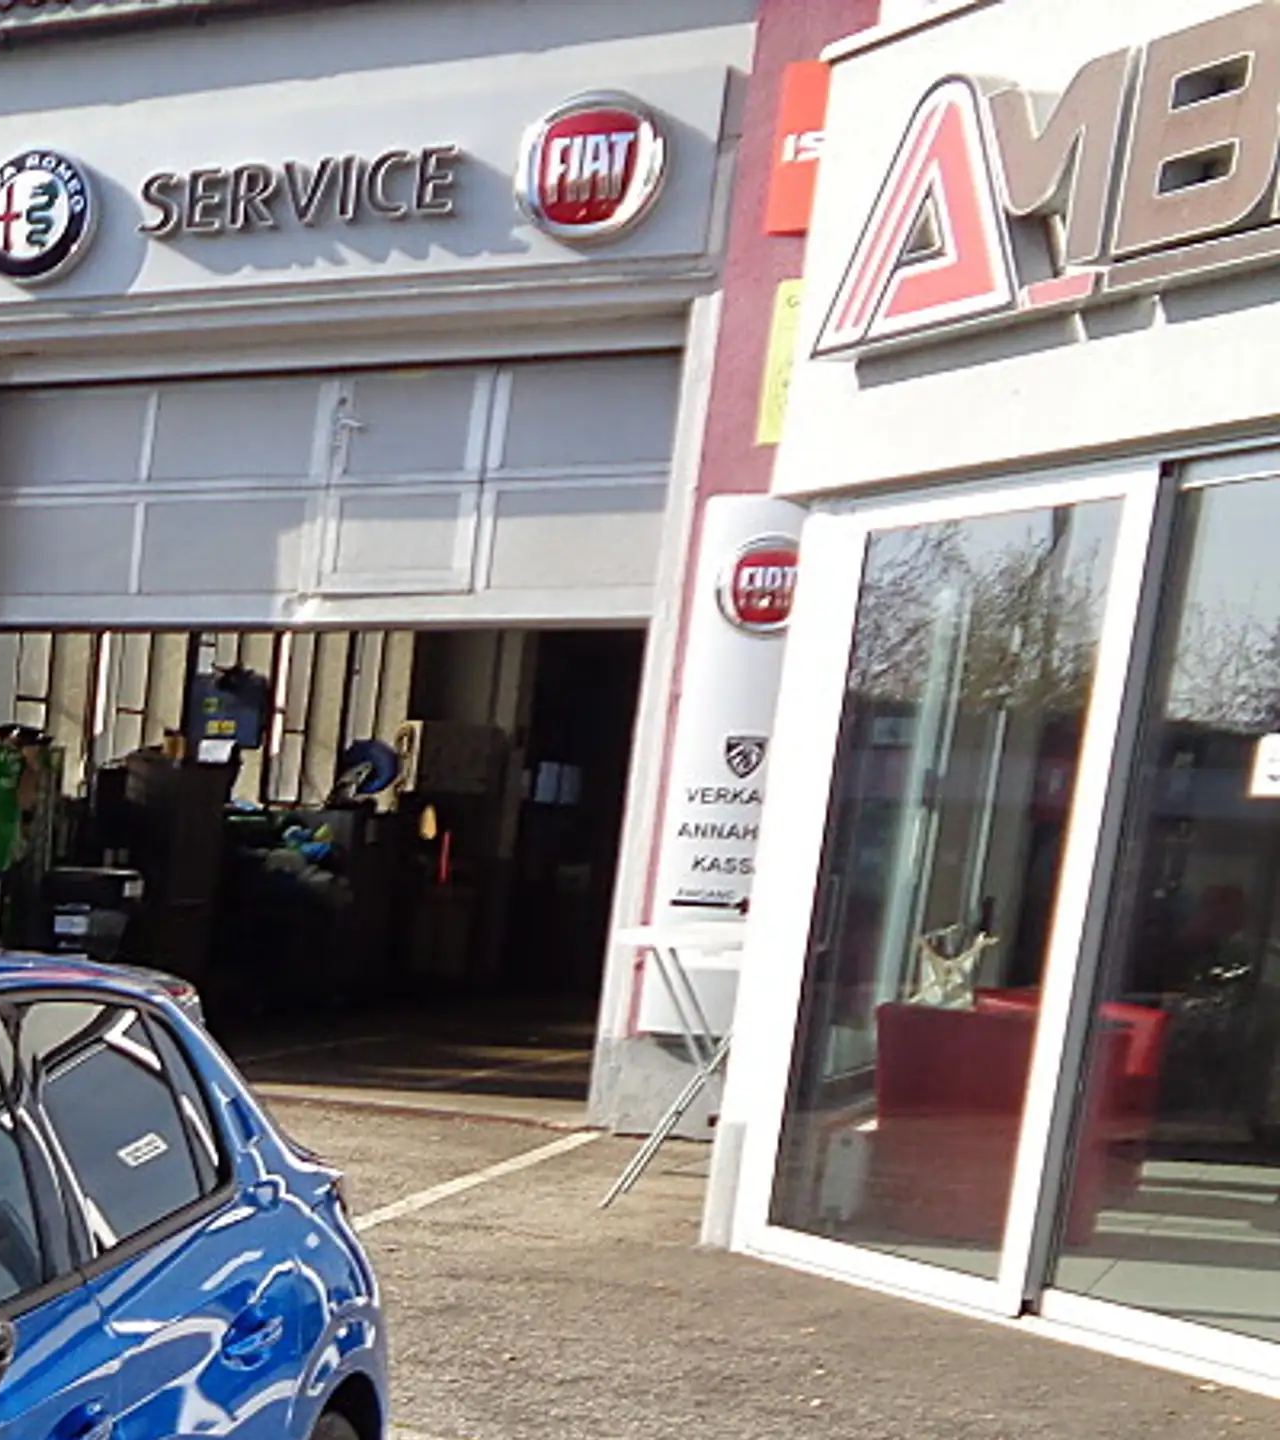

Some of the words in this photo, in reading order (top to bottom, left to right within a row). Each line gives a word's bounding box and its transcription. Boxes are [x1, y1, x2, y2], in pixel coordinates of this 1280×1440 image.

[25, 153, 86, 214] ROMEO
[137, 143, 461, 239] SERVICE
[545, 131, 636, 204] FIAT
[810, 0, 1280, 360] AMB
